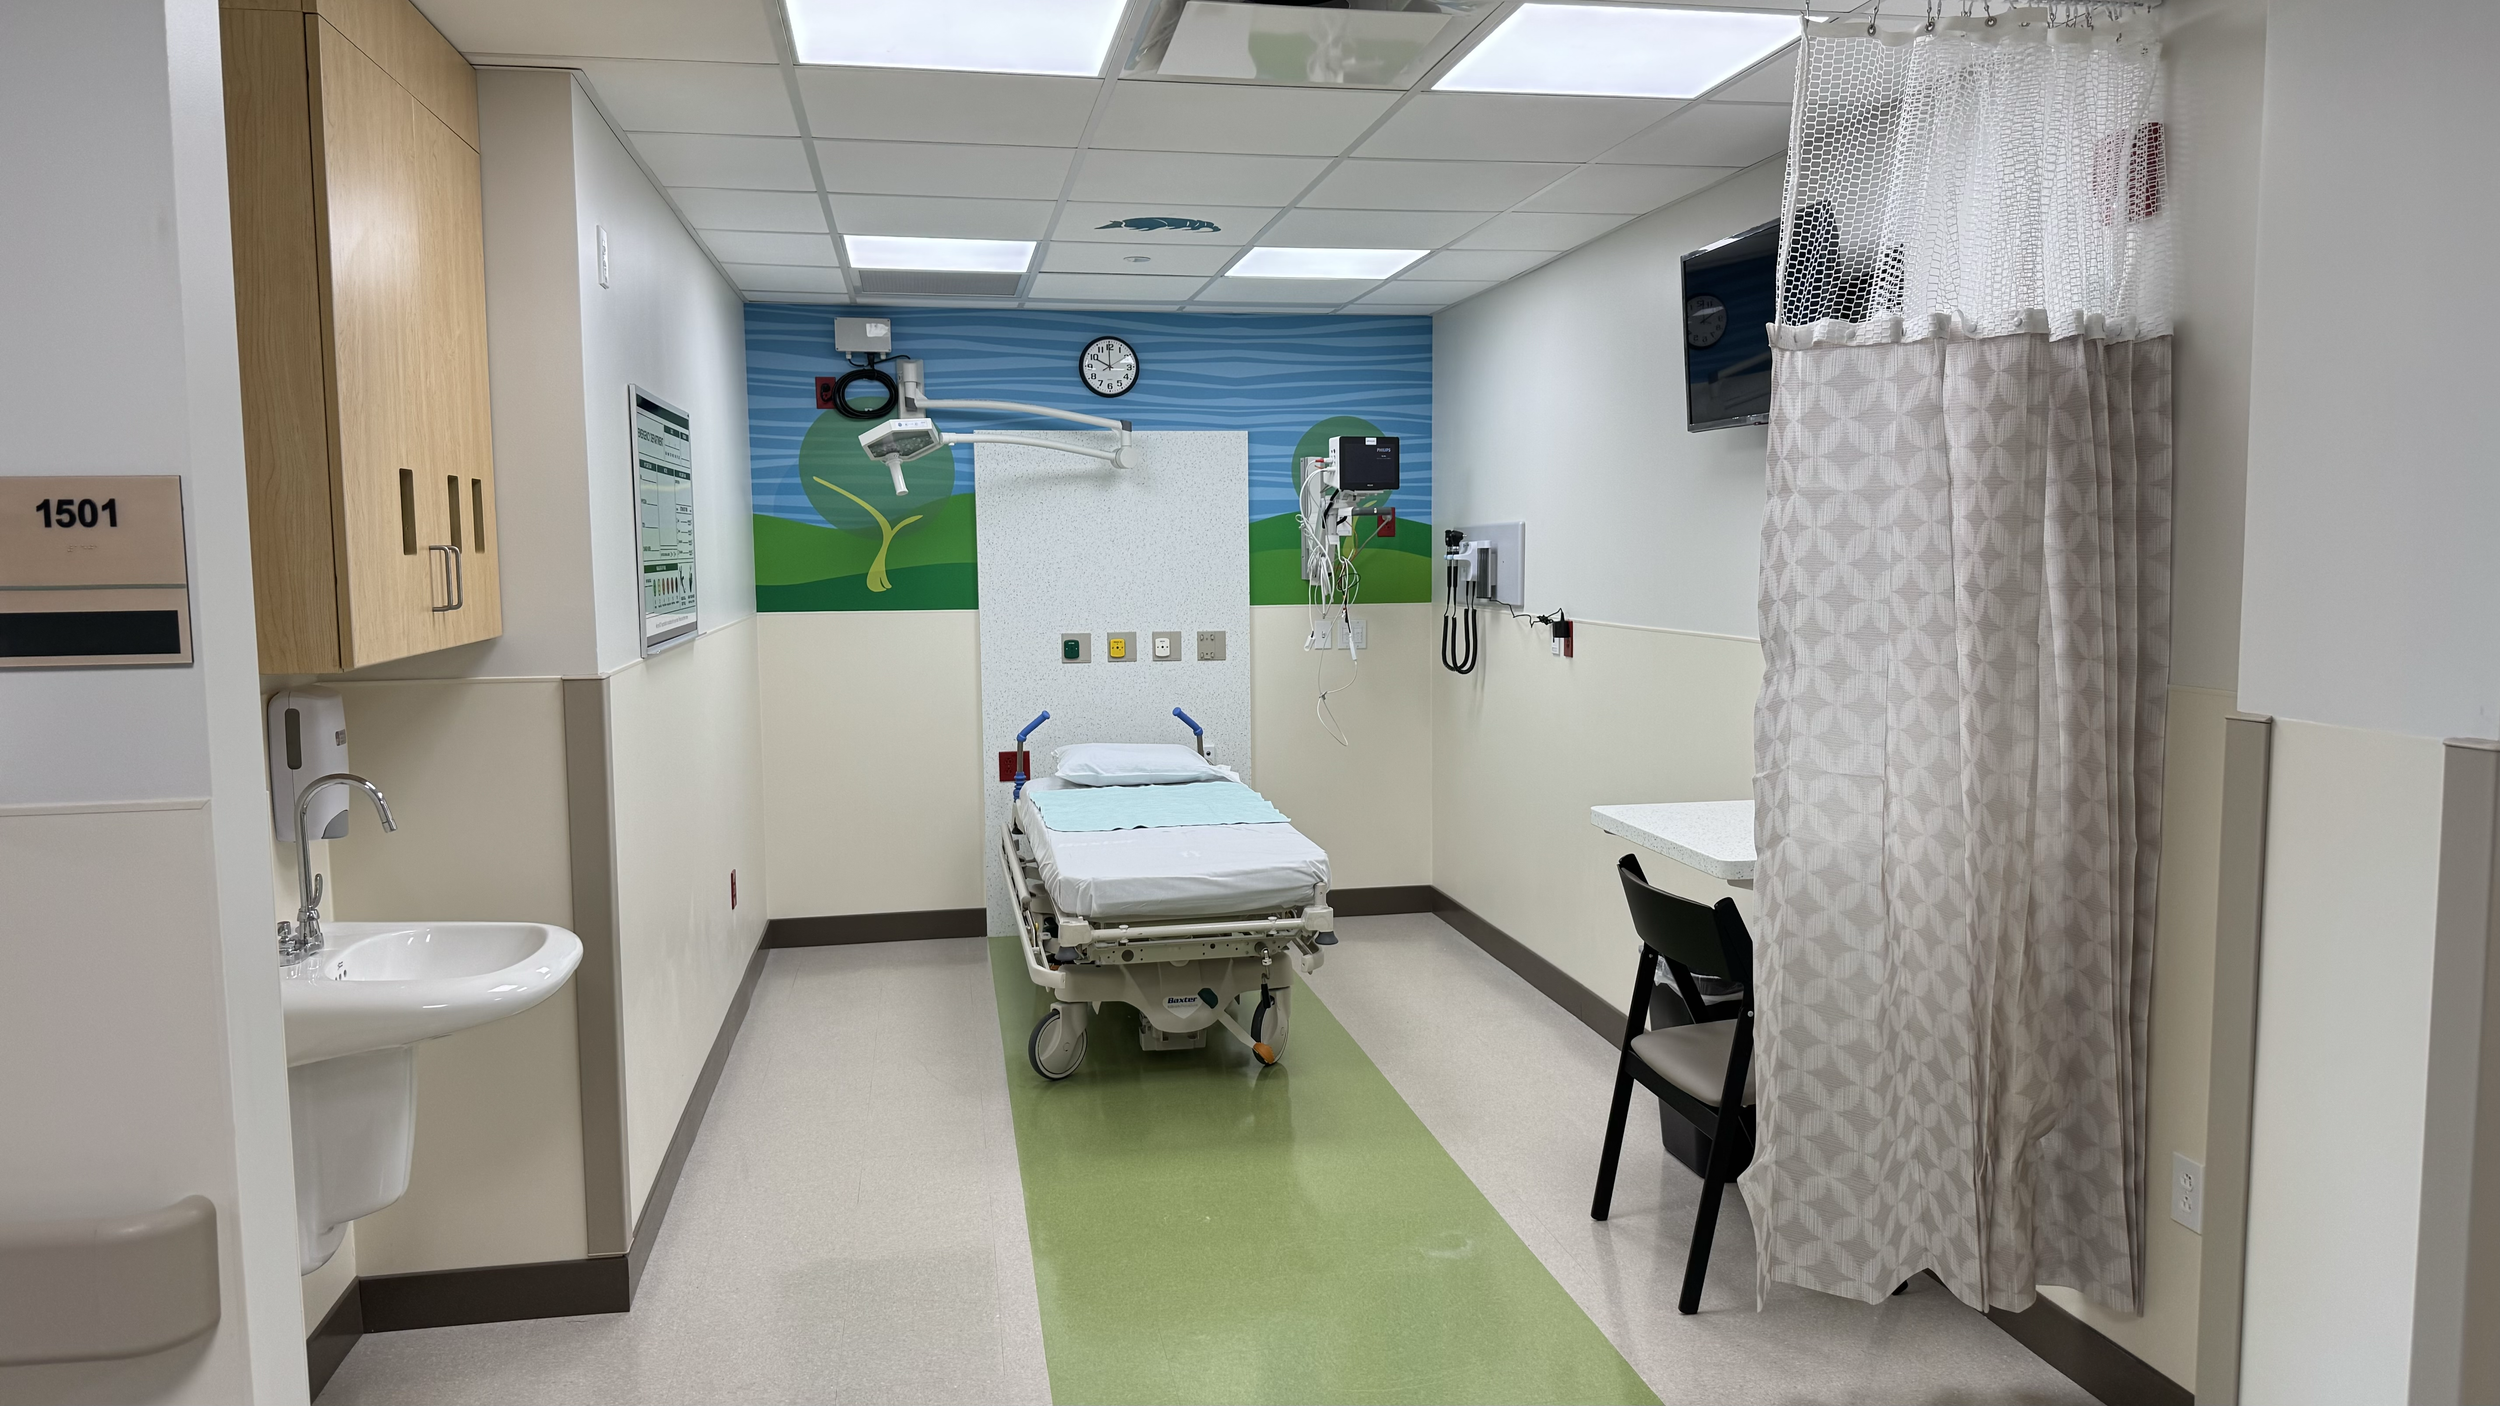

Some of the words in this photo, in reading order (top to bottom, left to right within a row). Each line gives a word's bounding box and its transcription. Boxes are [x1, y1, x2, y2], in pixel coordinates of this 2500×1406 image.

[1106, 343, 1114, 351] 12
[1090, 353, 1099, 361] 10
[35, 498, 118, 528] 1501
